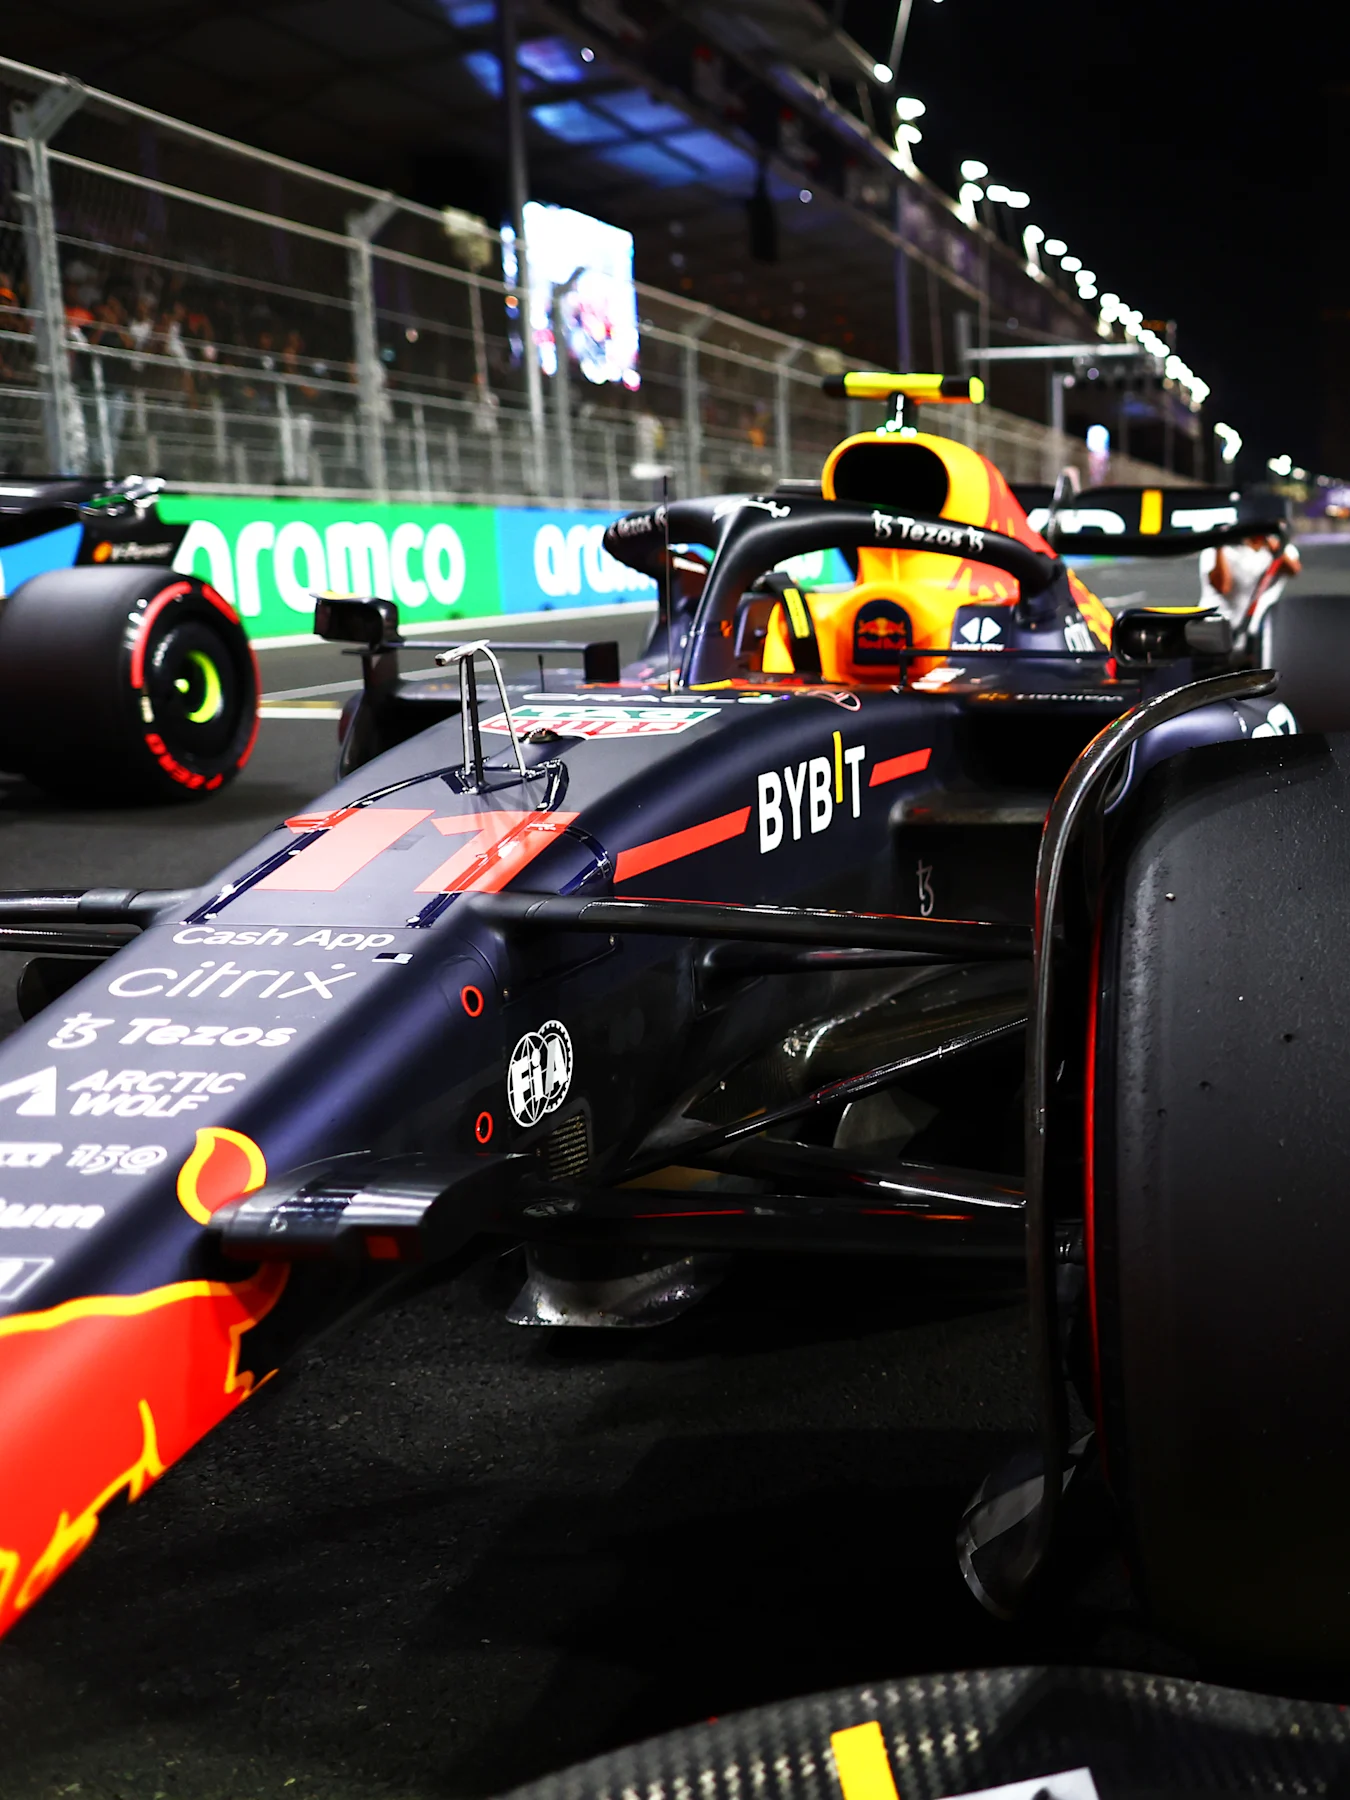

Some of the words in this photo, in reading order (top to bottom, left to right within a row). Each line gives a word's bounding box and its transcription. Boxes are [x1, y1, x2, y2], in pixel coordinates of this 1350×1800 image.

[897, 516, 963, 548] Tezos
[758, 731, 865, 854] BYBIT
[284, 808, 581, 893] 11
[172, 926, 289, 946] Cash
[293, 928, 395, 951] App
[108, 961, 357, 1000] citrix
[118, 1018, 297, 1047] Tezos
[66, 1069, 247, 1094] ARCTIC
[69, 1093, 210, 1118] WOLF
